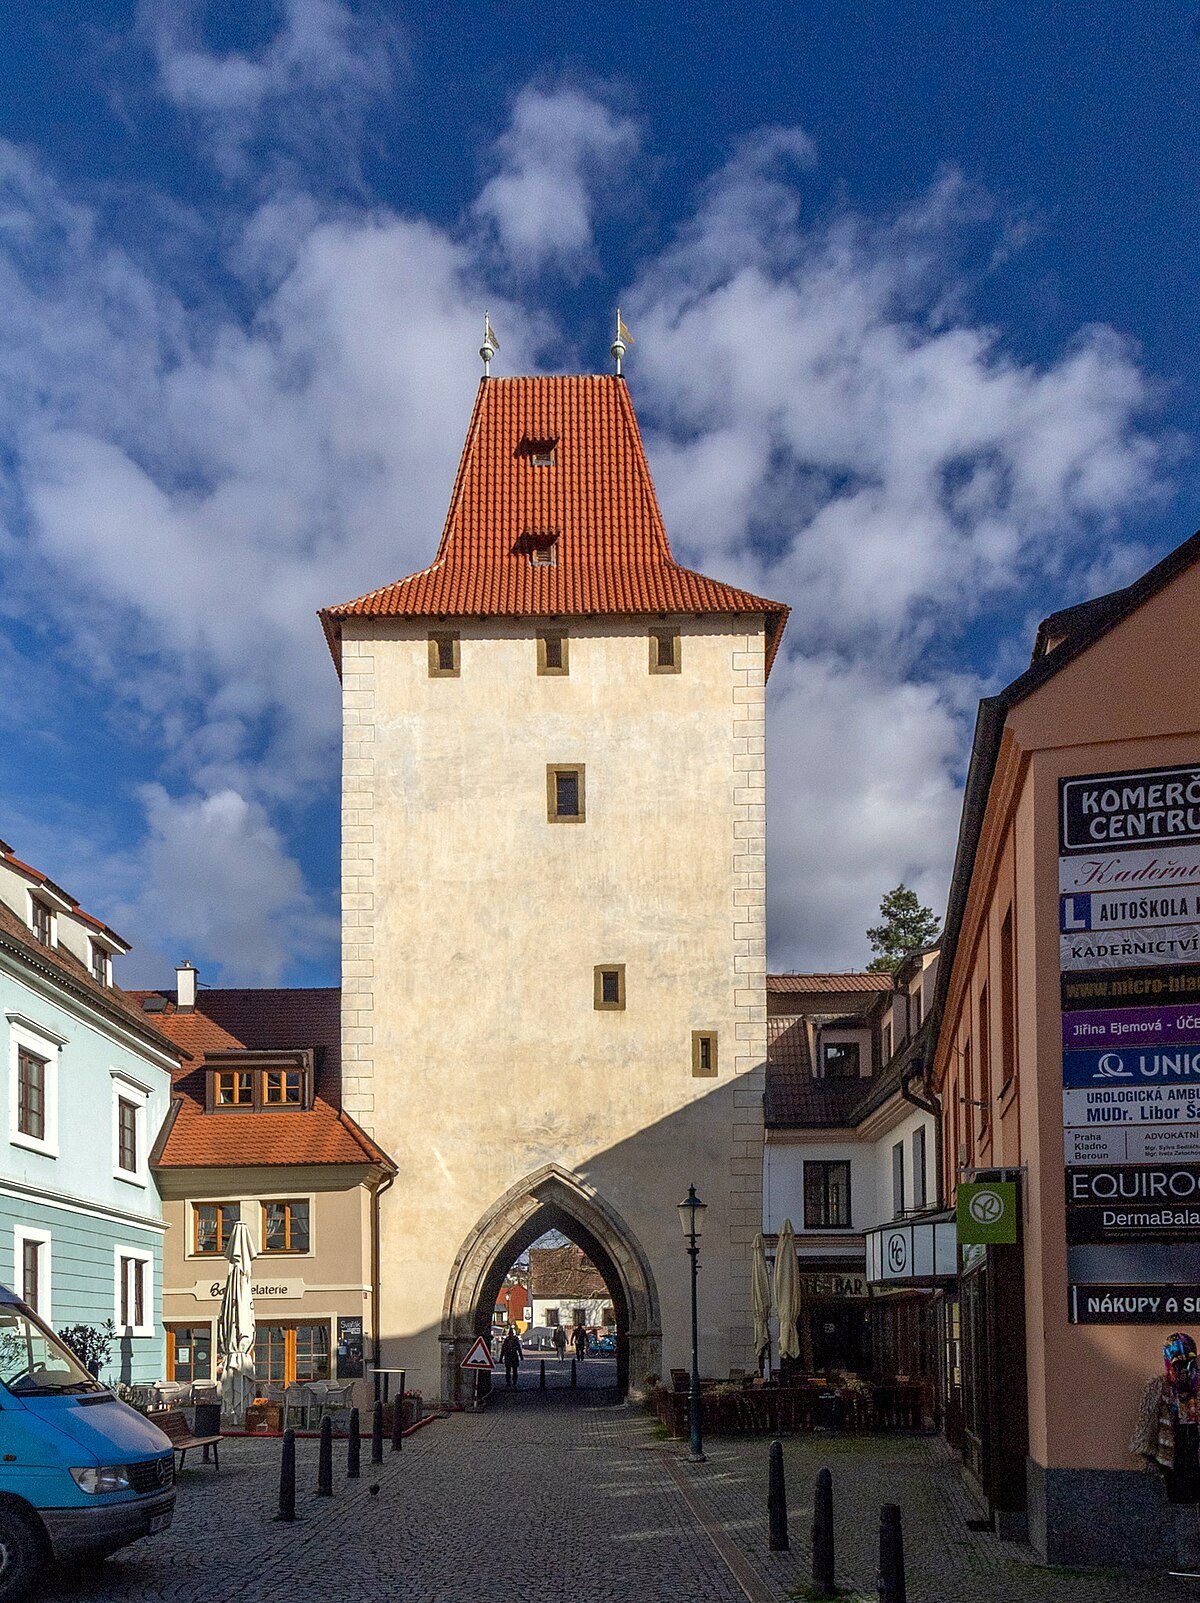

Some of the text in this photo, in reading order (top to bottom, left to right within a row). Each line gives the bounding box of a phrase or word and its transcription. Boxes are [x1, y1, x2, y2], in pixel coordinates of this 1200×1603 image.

[1082, 775, 1200, 814] KOMERČ
[1089, 808, 1200, 839] CENTRU
[1074, 859, 1200, 886] Kadeřni
[1100, 897, 1188, 921] AUTOŠKOLA
[1071, 934, 1198, 958] KADEŘNICTVÍ
[1073, 1024, 1106, 1036] Jiřina
[1110, 1020, 1162, 1035] Ejemová
[1087, 1087, 1162, 1104] UROLOGICKÁ
[1086, 1107, 1133, 1122] MUDr.
[1140, 1106, 1180, 1121] Libor
[1074, 1133, 1102, 1141] Praha
[1074, 1142, 1108, 1151] Kladno
[1074, 1151, 1109, 1160] Beroun
[1072, 1172, 1200, 1198] EQUIRO
[1103, 1209, 1200, 1226] DermaBala
[210, 1282, 288, 1297] Bo elaterie
[1087, 1293, 1160, 1313] NÁKUPY
[1165, 1297, 1178, 1313] A
